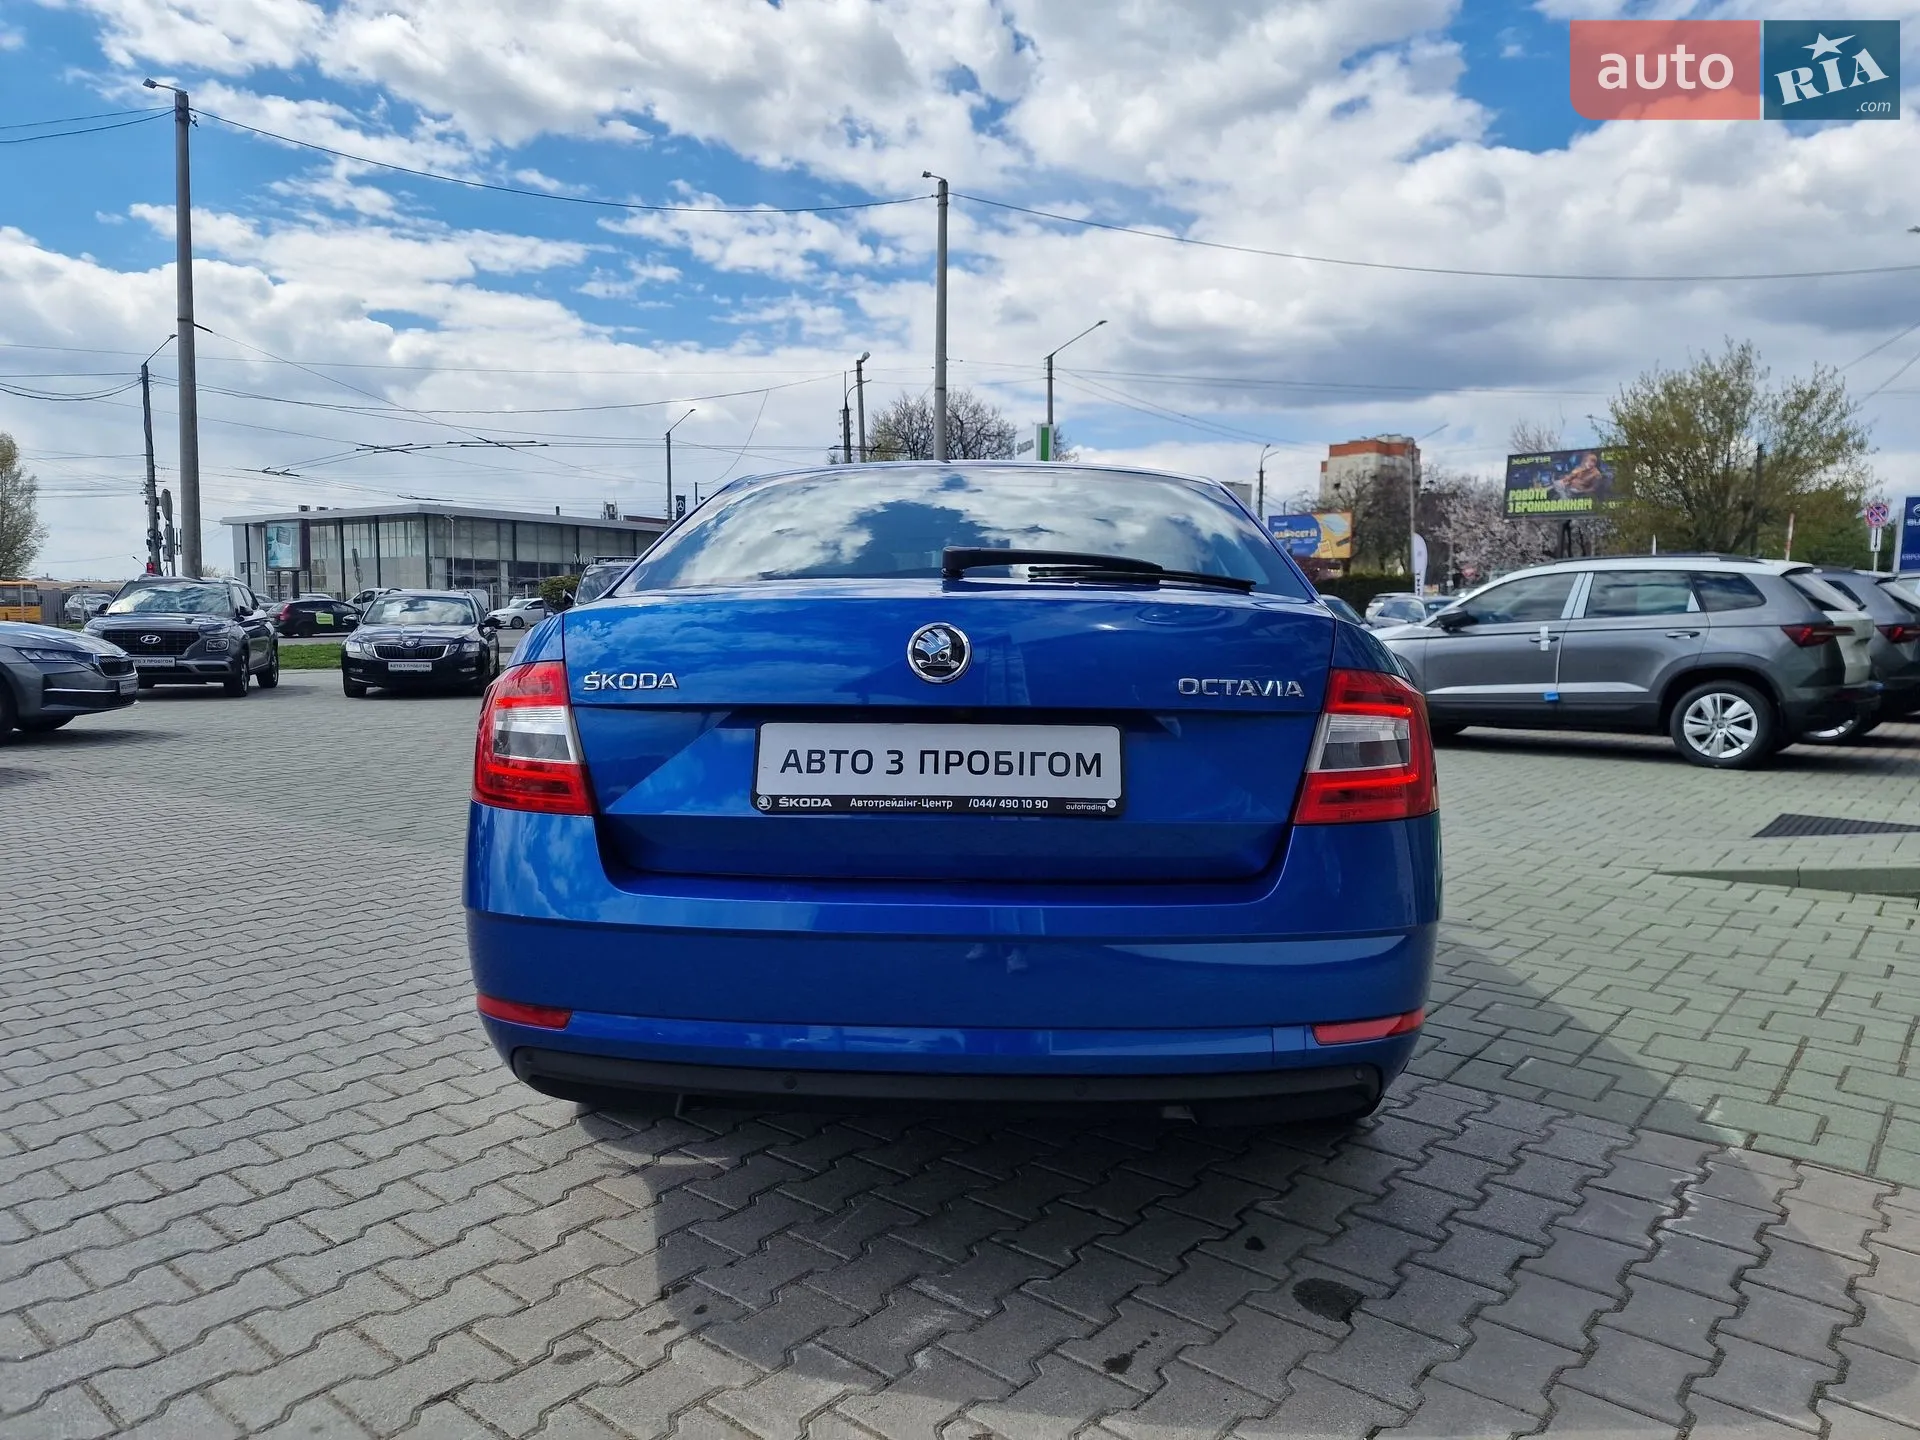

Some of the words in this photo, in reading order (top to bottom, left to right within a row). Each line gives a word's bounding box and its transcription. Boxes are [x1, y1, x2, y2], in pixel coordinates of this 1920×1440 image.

[583, 671, 679, 691] ŠKODA
[1178, 677, 1305, 698] OCTAVIA
[780, 748, 874, 775] АВТО
[885, 749, 904, 776] З
[919, 749, 1102, 778] ПРОБІГОМ
[778, 796, 832, 808] ŠKODA
[850, 797, 953, 810] Автотрейдінг-Центр
[968, 798, 996, 809] /044/
[999, 799, 1019, 809] 490
[1021, 799, 1033, 809] 10
[1035, 799, 1049, 809] 90
[1066, 803, 1106, 812] autotrading
